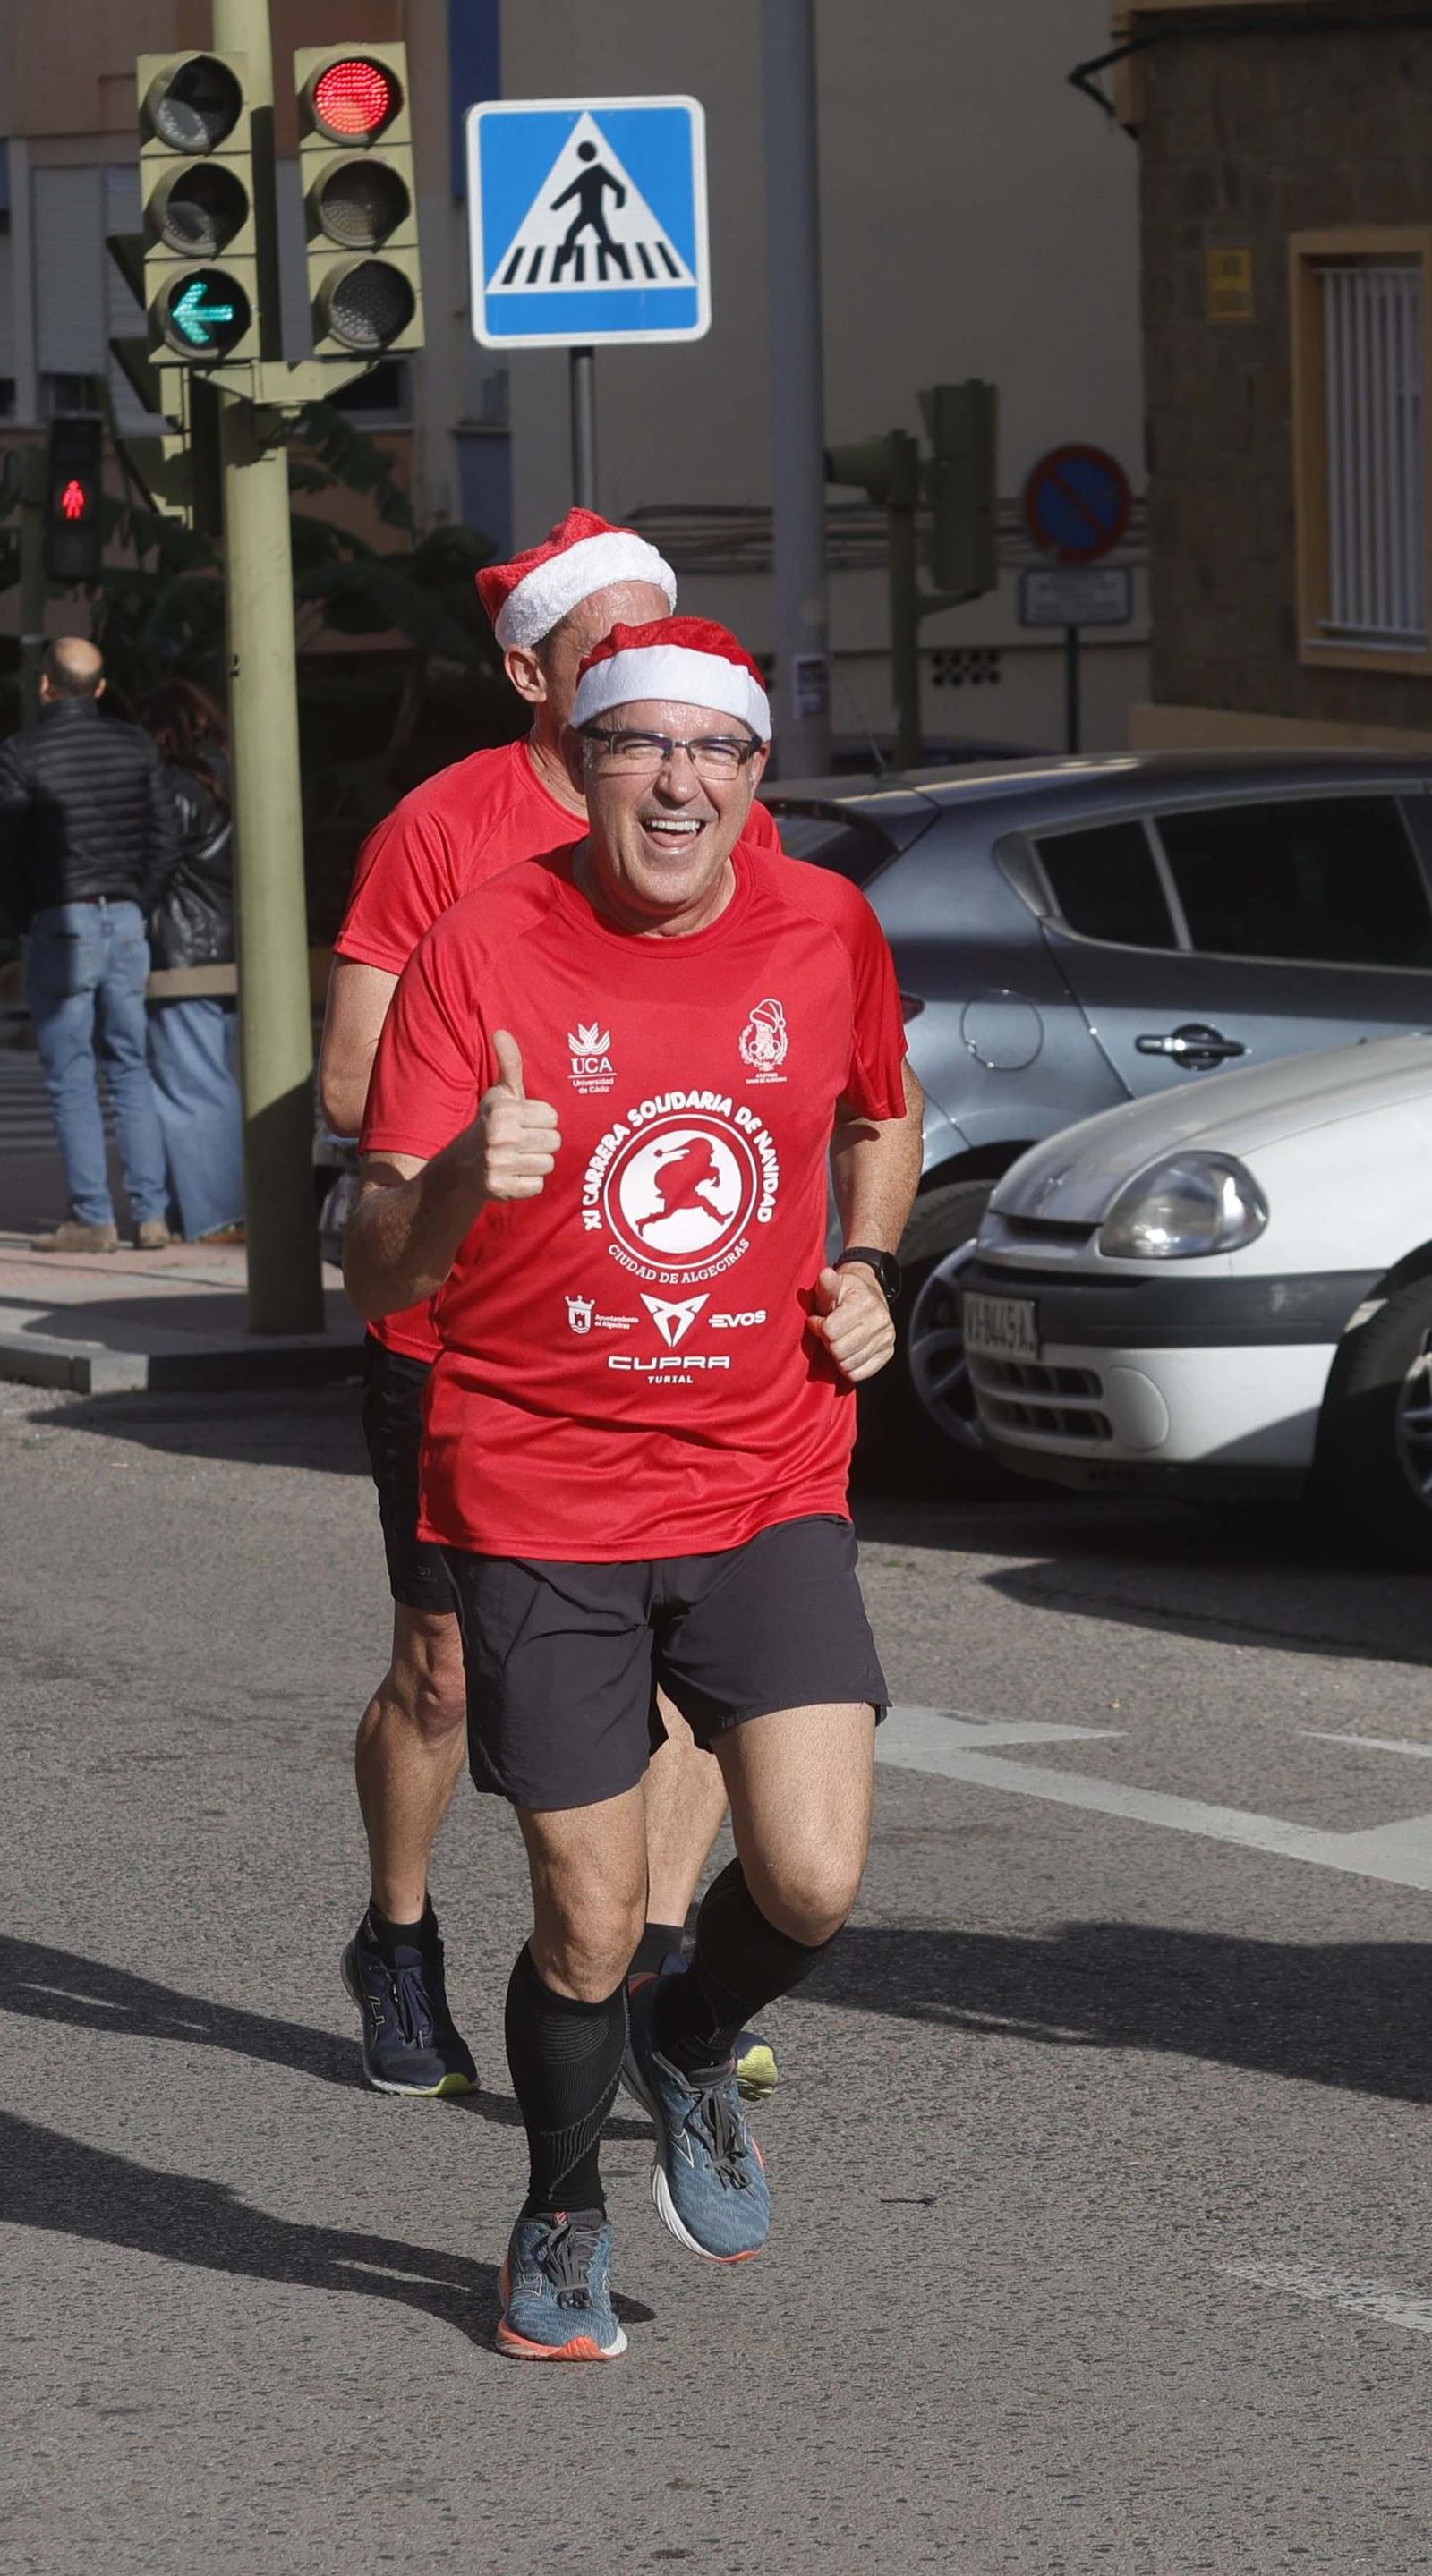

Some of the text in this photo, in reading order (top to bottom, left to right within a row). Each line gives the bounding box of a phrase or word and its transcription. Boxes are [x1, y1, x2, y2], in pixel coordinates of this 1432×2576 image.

[570, 1057, 613, 1075] UCA
[573, 1077, 615, 1087] Universidad
[582, 1090, 780, 1231] XI CARRERA SOLIDARIA DE NAVIDAD
[608, 1237, 750, 1285] CIUDAD DE ALGECIRAS
[594, 1314, 639, 1324] Ayuntamiento
[601, 1322, 631, 1331] Algeciras
[608, 1356, 730, 1371] CUPRA
[647, 1375, 694, 1384] TURIAL
